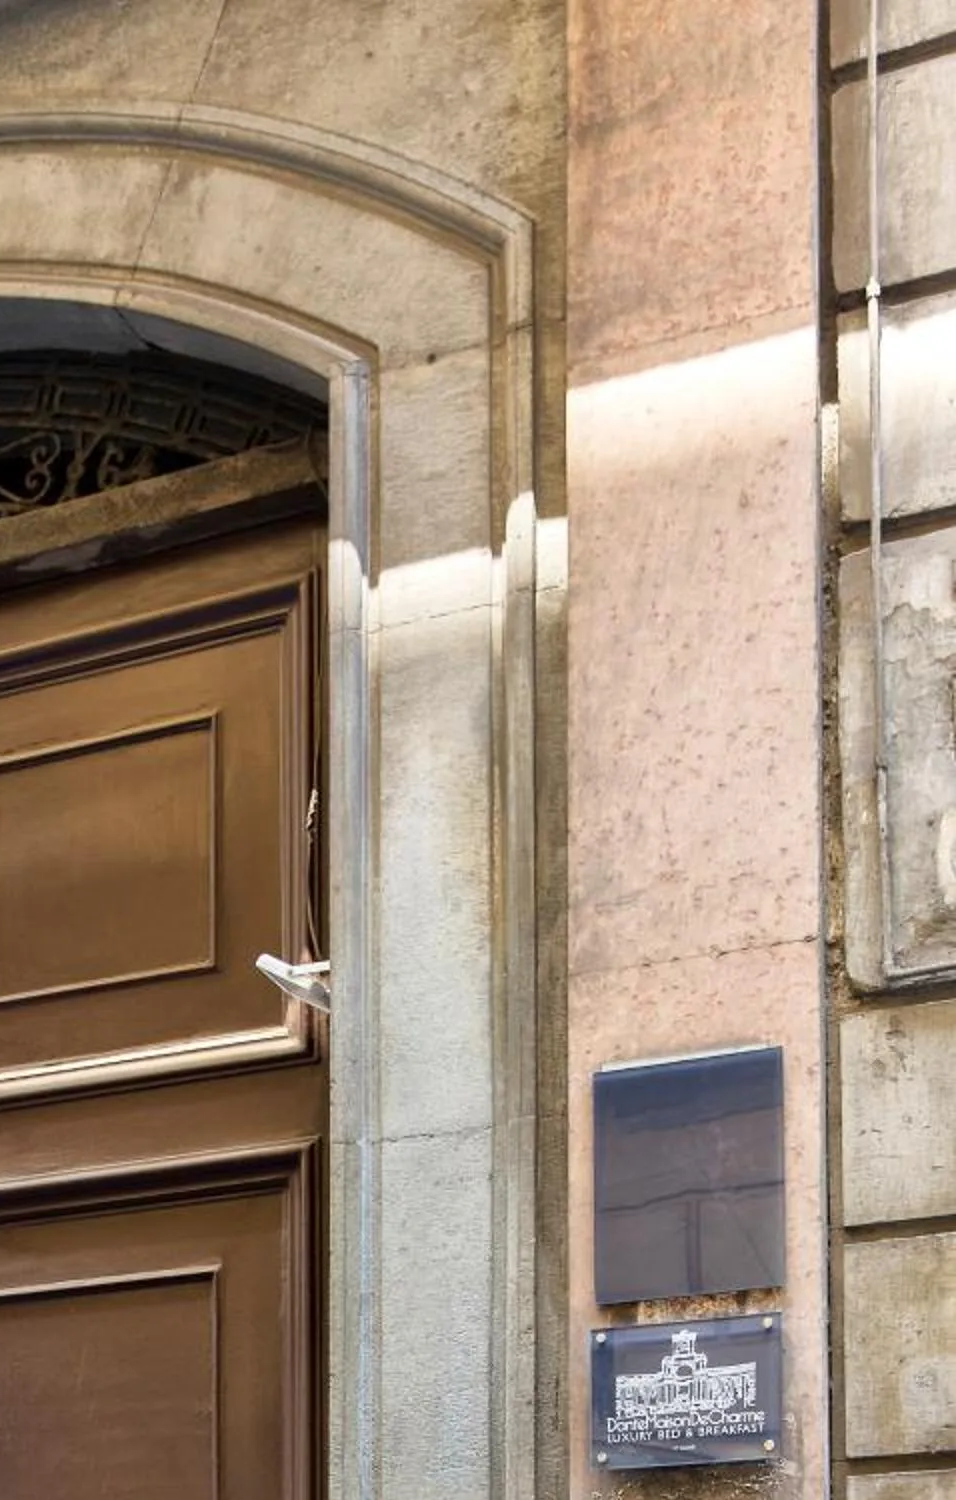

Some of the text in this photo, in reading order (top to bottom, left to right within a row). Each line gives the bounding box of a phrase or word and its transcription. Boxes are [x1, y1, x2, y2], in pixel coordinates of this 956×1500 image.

[607, 1431, 653, 1443] LUXURY
[657, 1429, 681, 1440] BED
[697, 1422, 766, 1437] BREAKFAST
